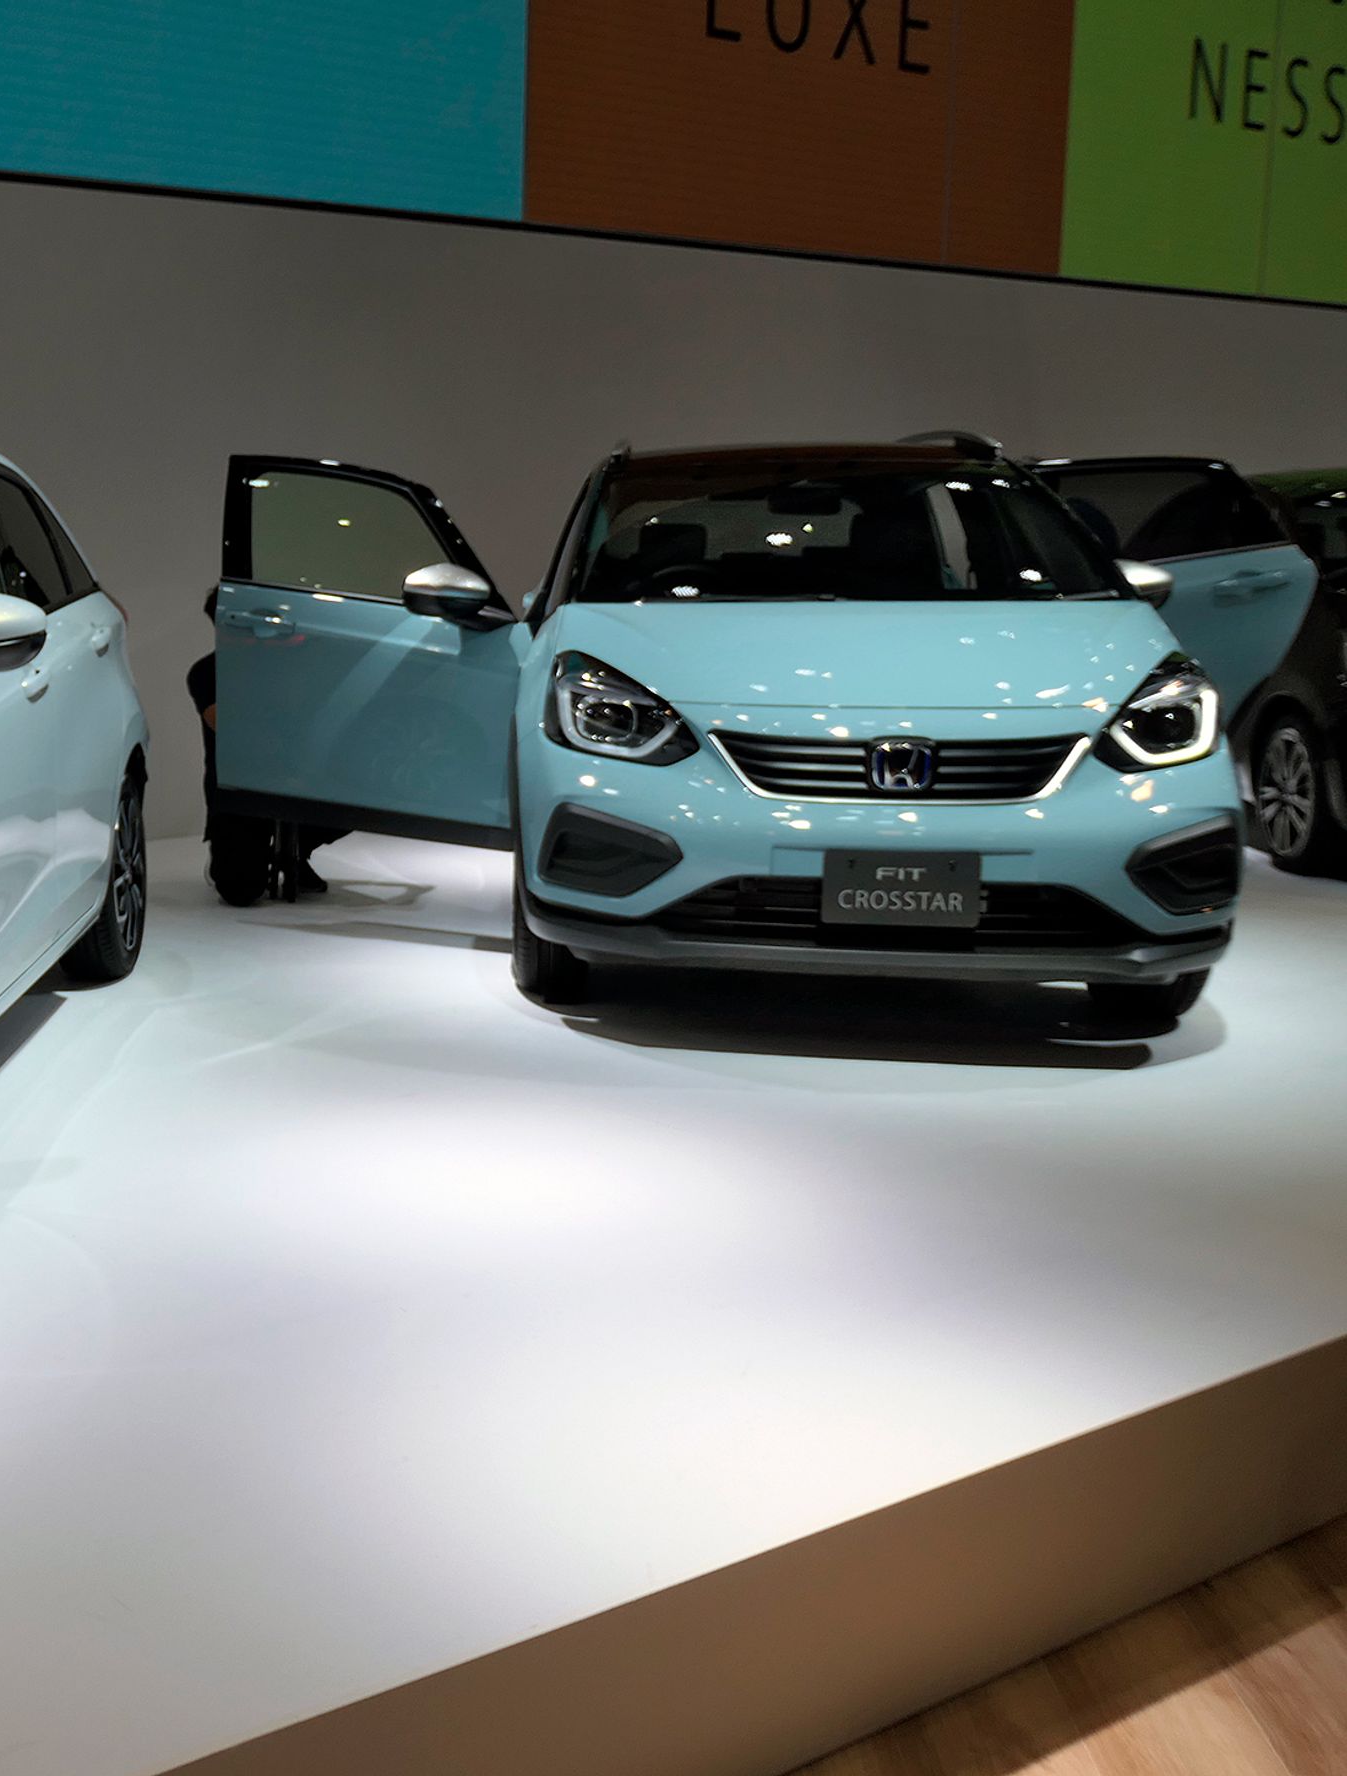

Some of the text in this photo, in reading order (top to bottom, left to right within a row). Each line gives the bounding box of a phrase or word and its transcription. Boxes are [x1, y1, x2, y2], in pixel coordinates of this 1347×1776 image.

[1189, 38, 1347, 145] NESS
[875, 867, 927, 881] FIT
[837, 889, 963, 911] CROSSTAR
